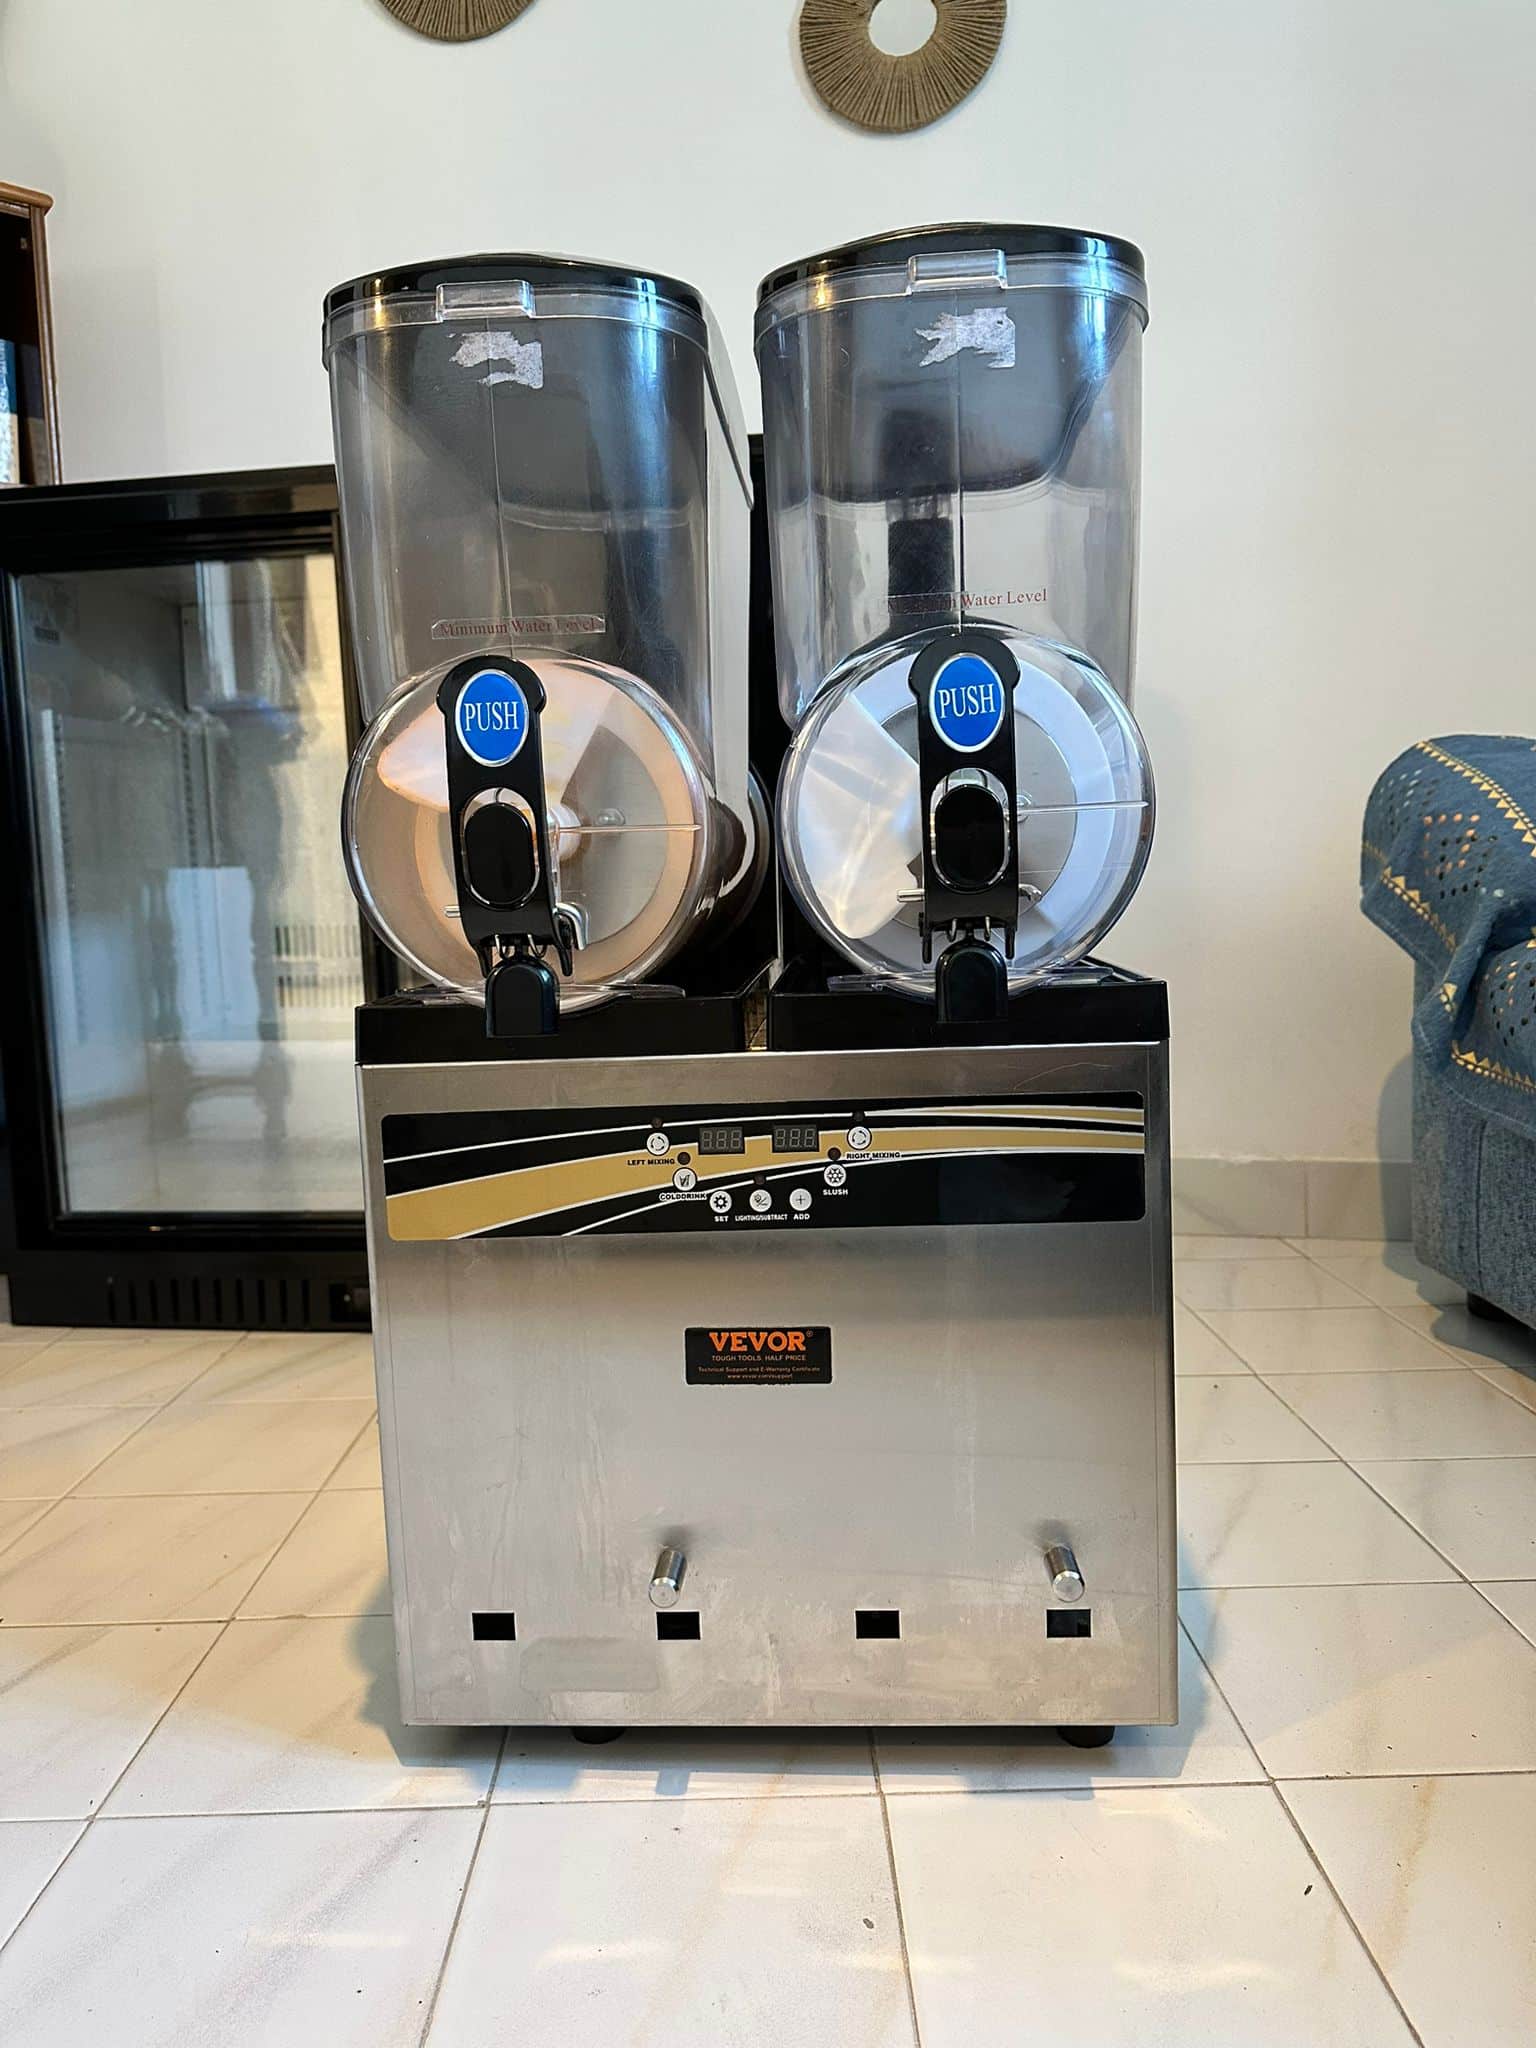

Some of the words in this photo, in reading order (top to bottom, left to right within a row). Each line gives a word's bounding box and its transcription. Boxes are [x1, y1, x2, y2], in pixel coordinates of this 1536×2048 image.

[961, 593, 1002, 608] Water
[1007, 588, 1047, 604] Level
[440, 622, 508, 637] Minimum
[511, 619, 552, 633] Water
[937, 683, 996, 718] PUSH
[463, 701, 520, 731] PUSH
[846, 1152, 870, 1160] RIGHT
[872, 1151, 900, 1159] MIXING
[647, 1158, 675, 1166] MIXING
[659, 1192, 708, 1201] COLDDRINK
[822, 1188, 849, 1196] SLUSH
[793, 1213, 810, 1221] ADD
[708, 1331, 806, 1352] VEVOR
[712, 1354, 736, 1362] TOUGH
[738, 1354, 762, 1362] TOOLS
